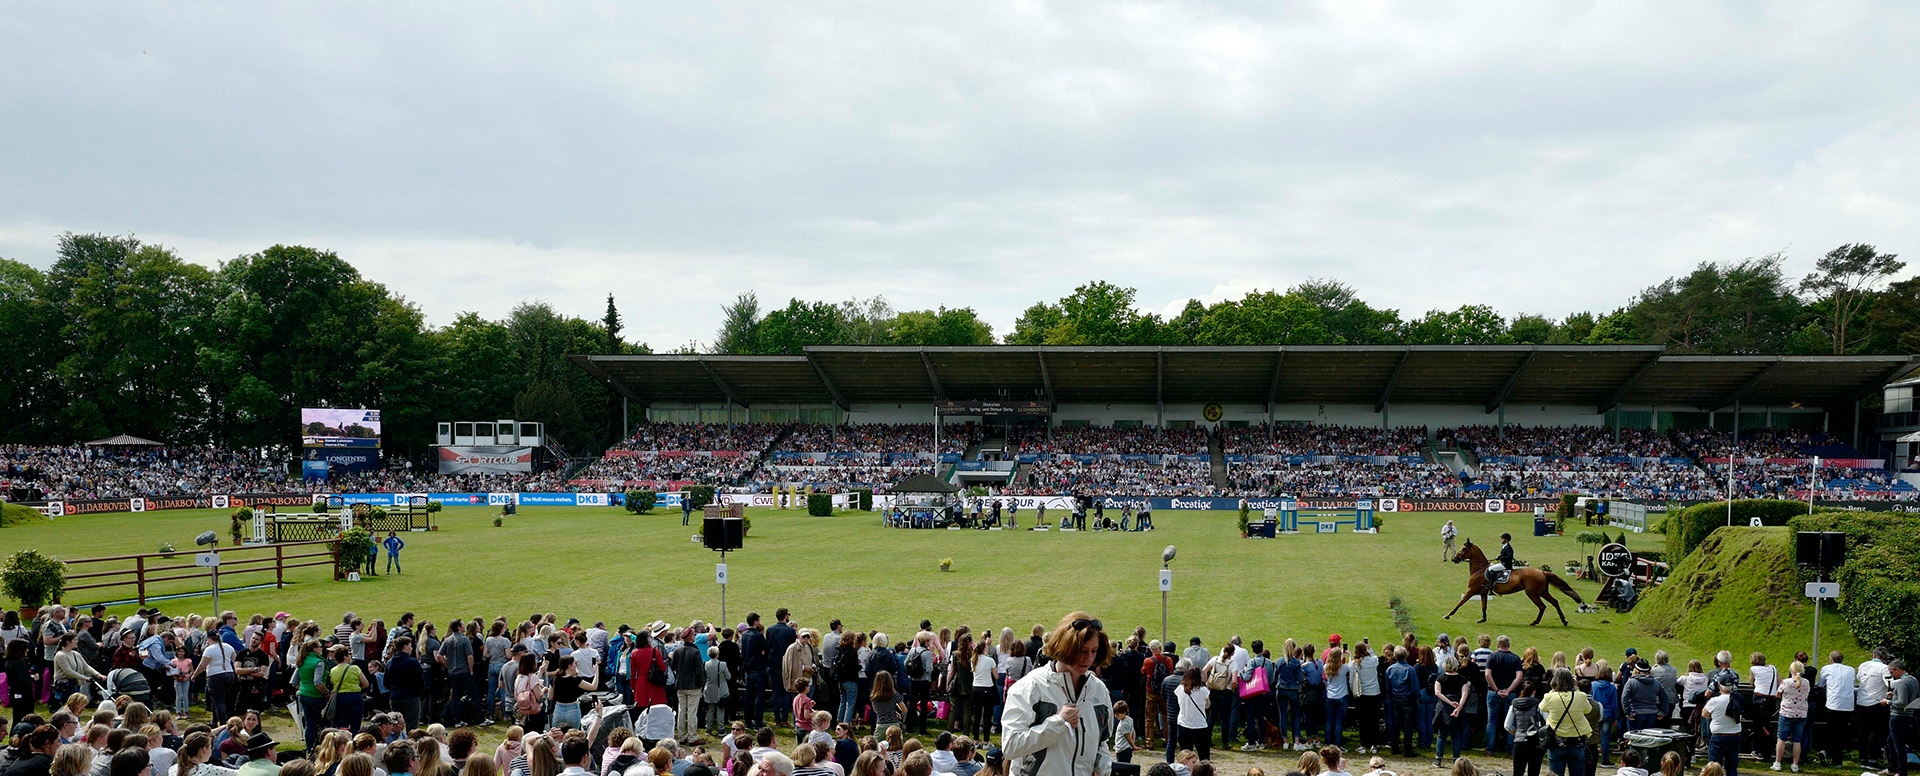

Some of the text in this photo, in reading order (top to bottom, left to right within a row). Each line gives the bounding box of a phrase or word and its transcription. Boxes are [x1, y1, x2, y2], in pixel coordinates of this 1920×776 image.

[456, 454, 518, 467] SPORTCLUB
[579, 496, 598, 504] DKB
[1172, 499, 1212, 510] Prestige
